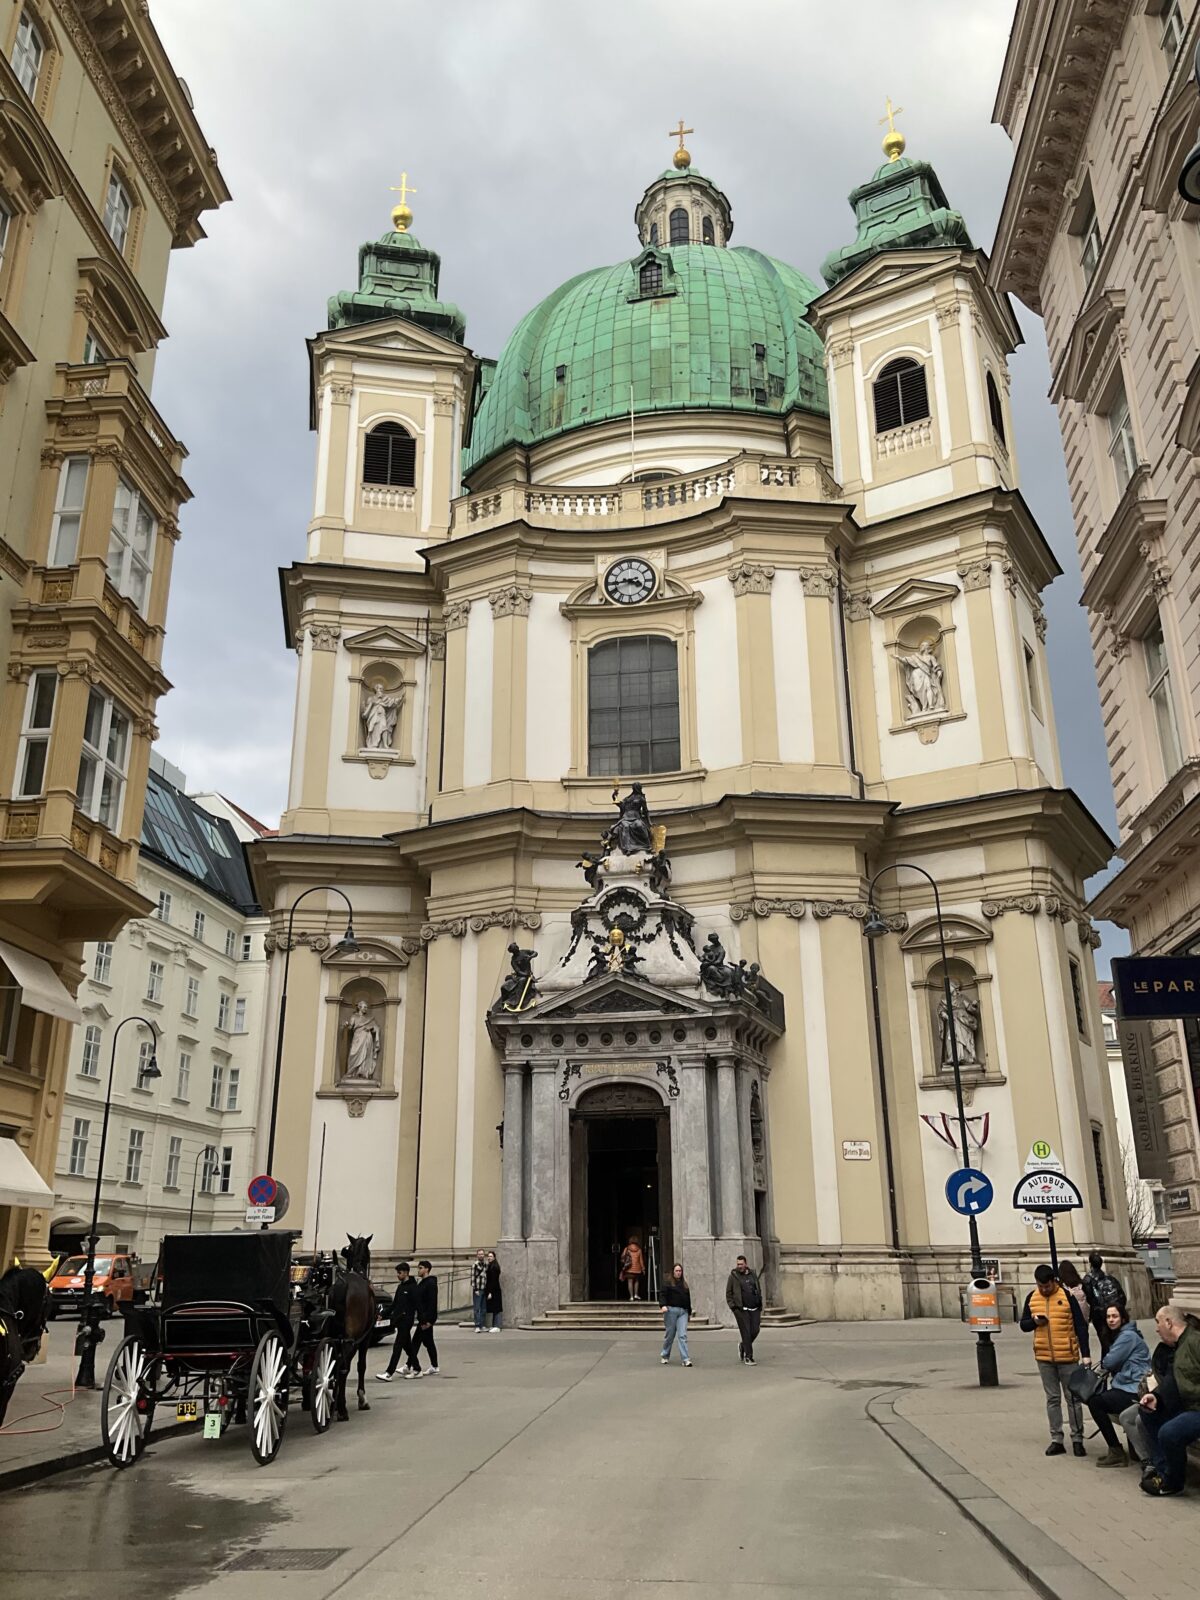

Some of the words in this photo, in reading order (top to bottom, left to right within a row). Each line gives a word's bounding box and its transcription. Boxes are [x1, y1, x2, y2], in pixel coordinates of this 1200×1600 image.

[1133, 981, 1149, 990] LE
[1153, 980, 1195, 993] PAR
[1126, 1032, 1142, 1091] BERKING
[1036, 1144, 1047, 1155] H
[1027, 1175, 1065, 1190] AUTOBUS
[1022, 1195, 1073, 1204] HALTESTELLE
[178, 1402, 196, 1414] F135
[210, 1419, 216, 1427] 3
